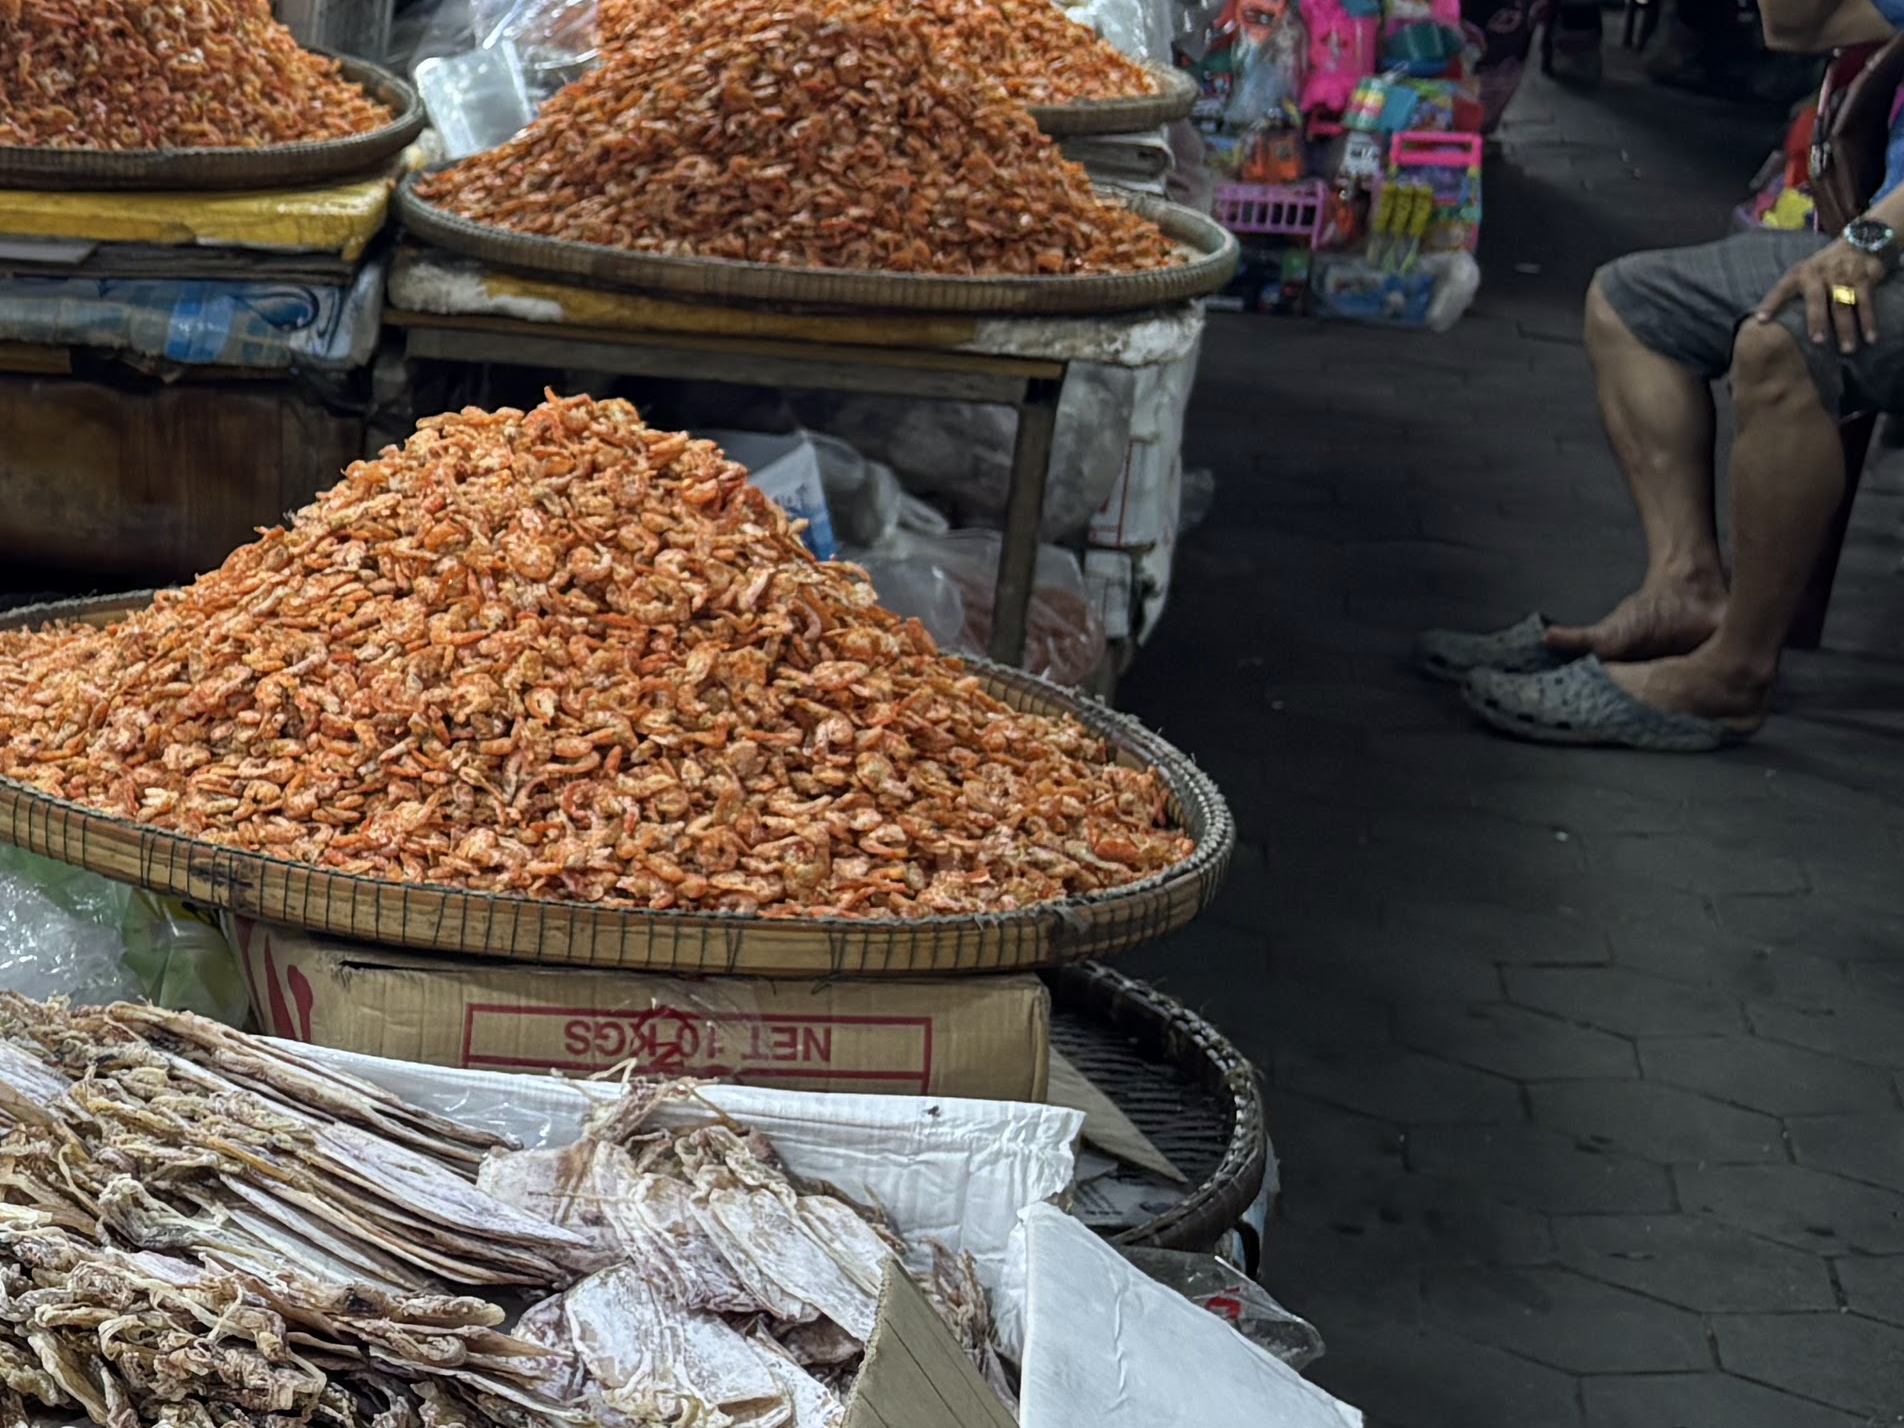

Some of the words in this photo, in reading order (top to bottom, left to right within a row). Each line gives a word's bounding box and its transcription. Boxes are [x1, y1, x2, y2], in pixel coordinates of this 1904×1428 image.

[563, 1018, 661, 1060] KGS
[678, 1019, 719, 1060] 10
[741, 1025, 833, 1063] NET
